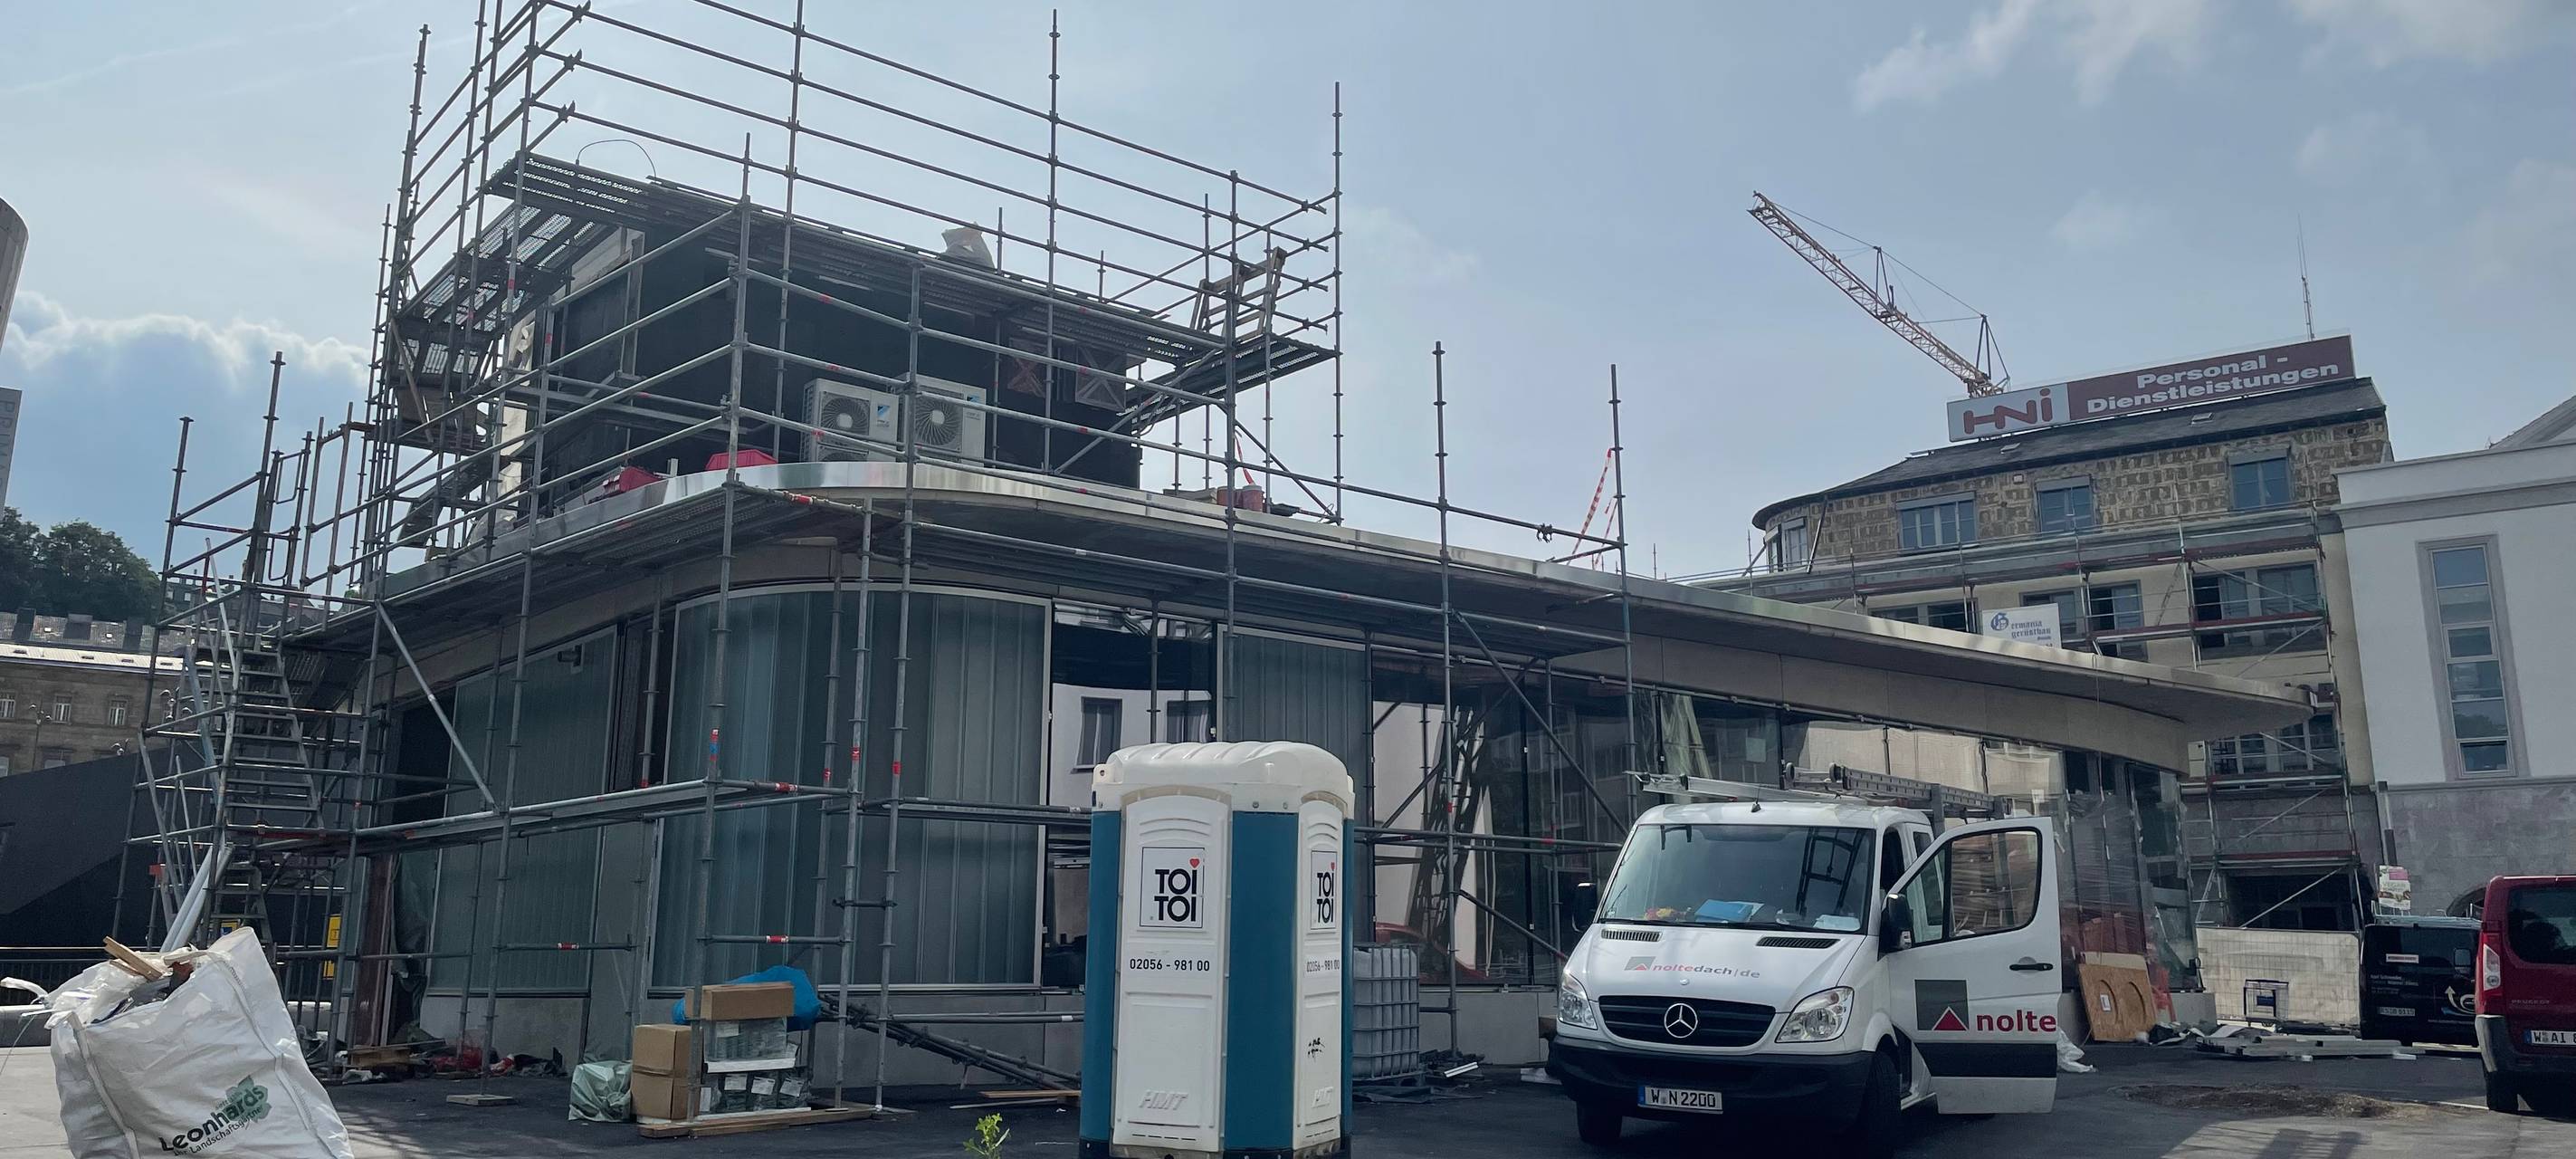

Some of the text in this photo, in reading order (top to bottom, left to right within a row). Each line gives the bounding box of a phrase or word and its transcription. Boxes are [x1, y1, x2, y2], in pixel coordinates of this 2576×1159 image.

[2137, 355, 2267, 390] Personal
[2086, 362, 2339, 415] Dienstleistungen
[1153, 896, 1197, 923] TOI
[1317, 898, 1334, 924] TOI
[1130, 958, 1163, 970] 02056
[1174, 960, 1192, 972] 981
[1197, 960, 1210, 972] 00
[1976, 1010, 2056, 1032] nolte
[2533, 1031, 2542, 1043] W
[158, 1087, 264, 1152] Leonhards
